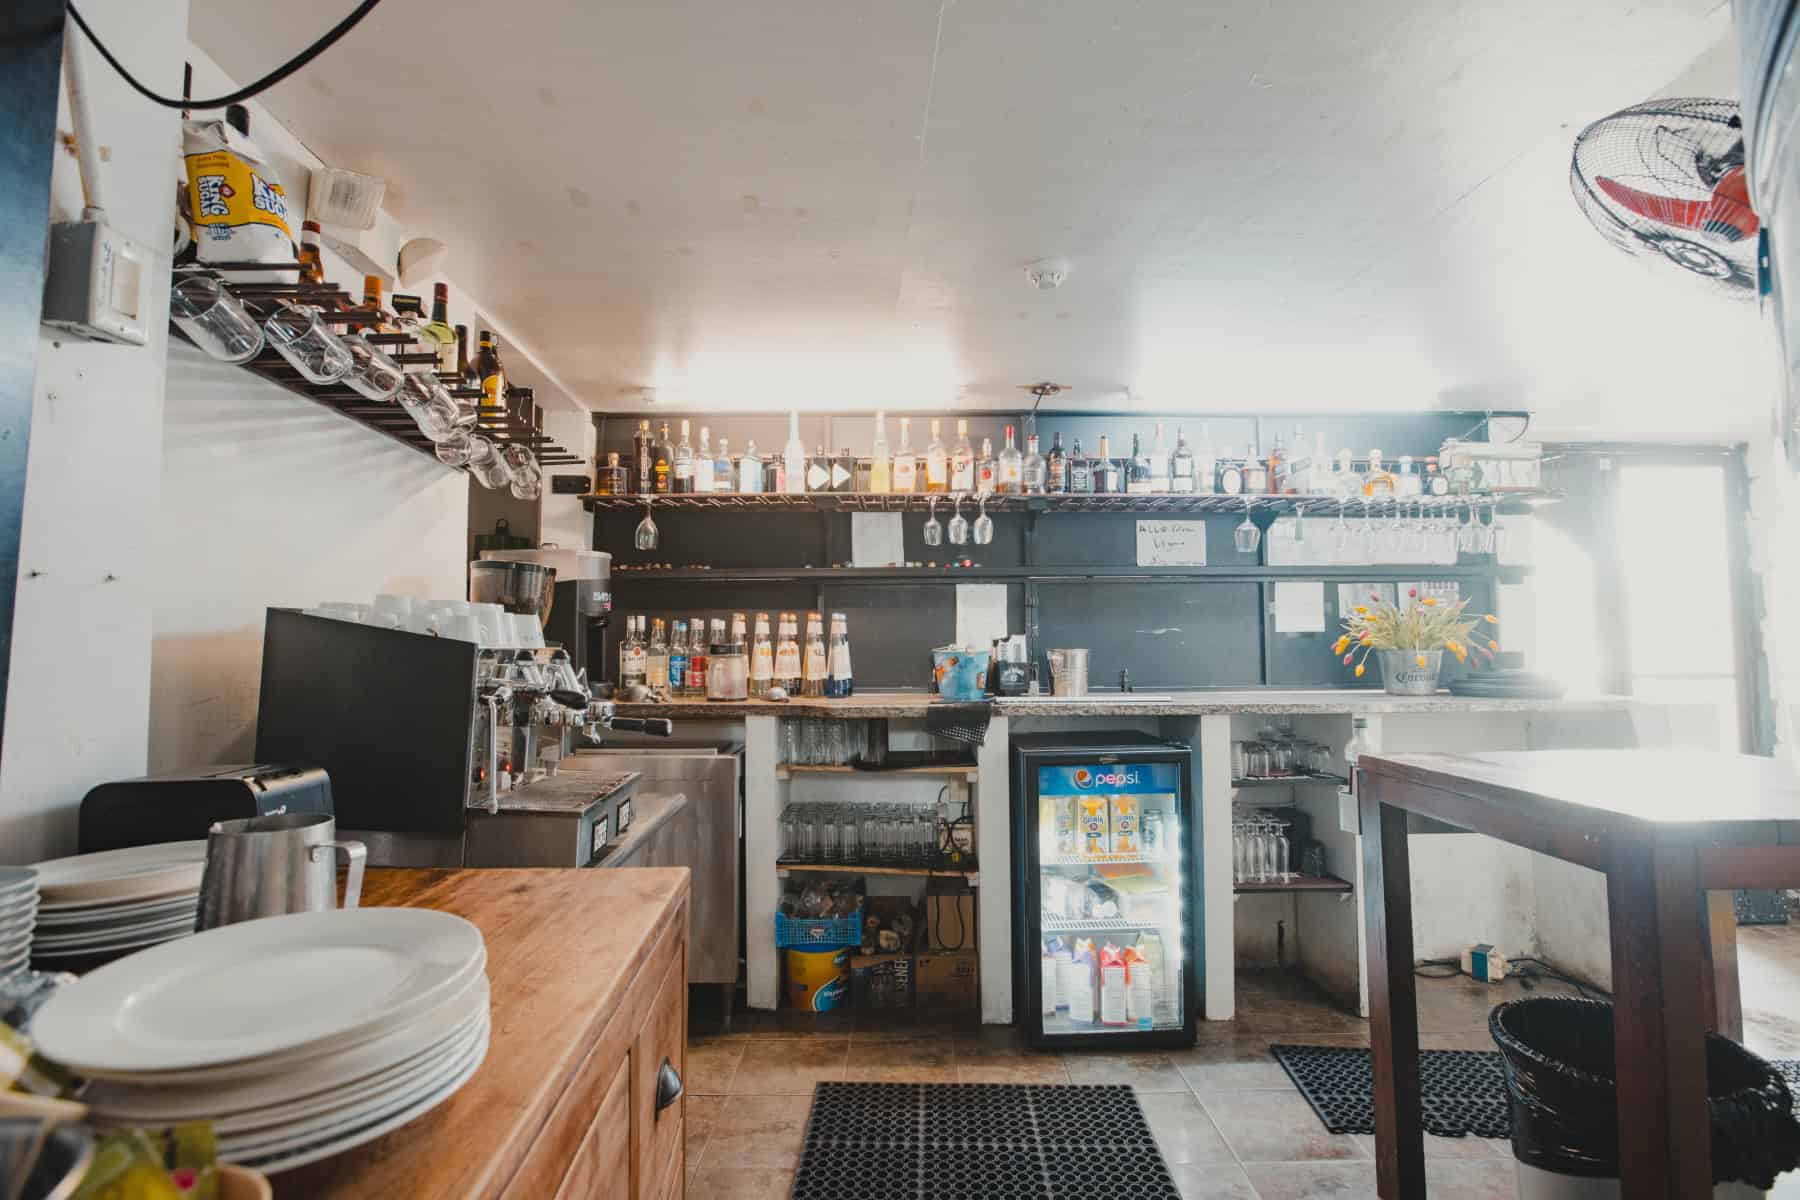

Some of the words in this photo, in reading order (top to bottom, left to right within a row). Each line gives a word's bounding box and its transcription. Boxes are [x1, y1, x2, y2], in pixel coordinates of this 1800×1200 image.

[198, 175, 210, 217] SUGAR
[205, 175, 230, 216] KING
[1095, 770, 1139, 788] pepsi
